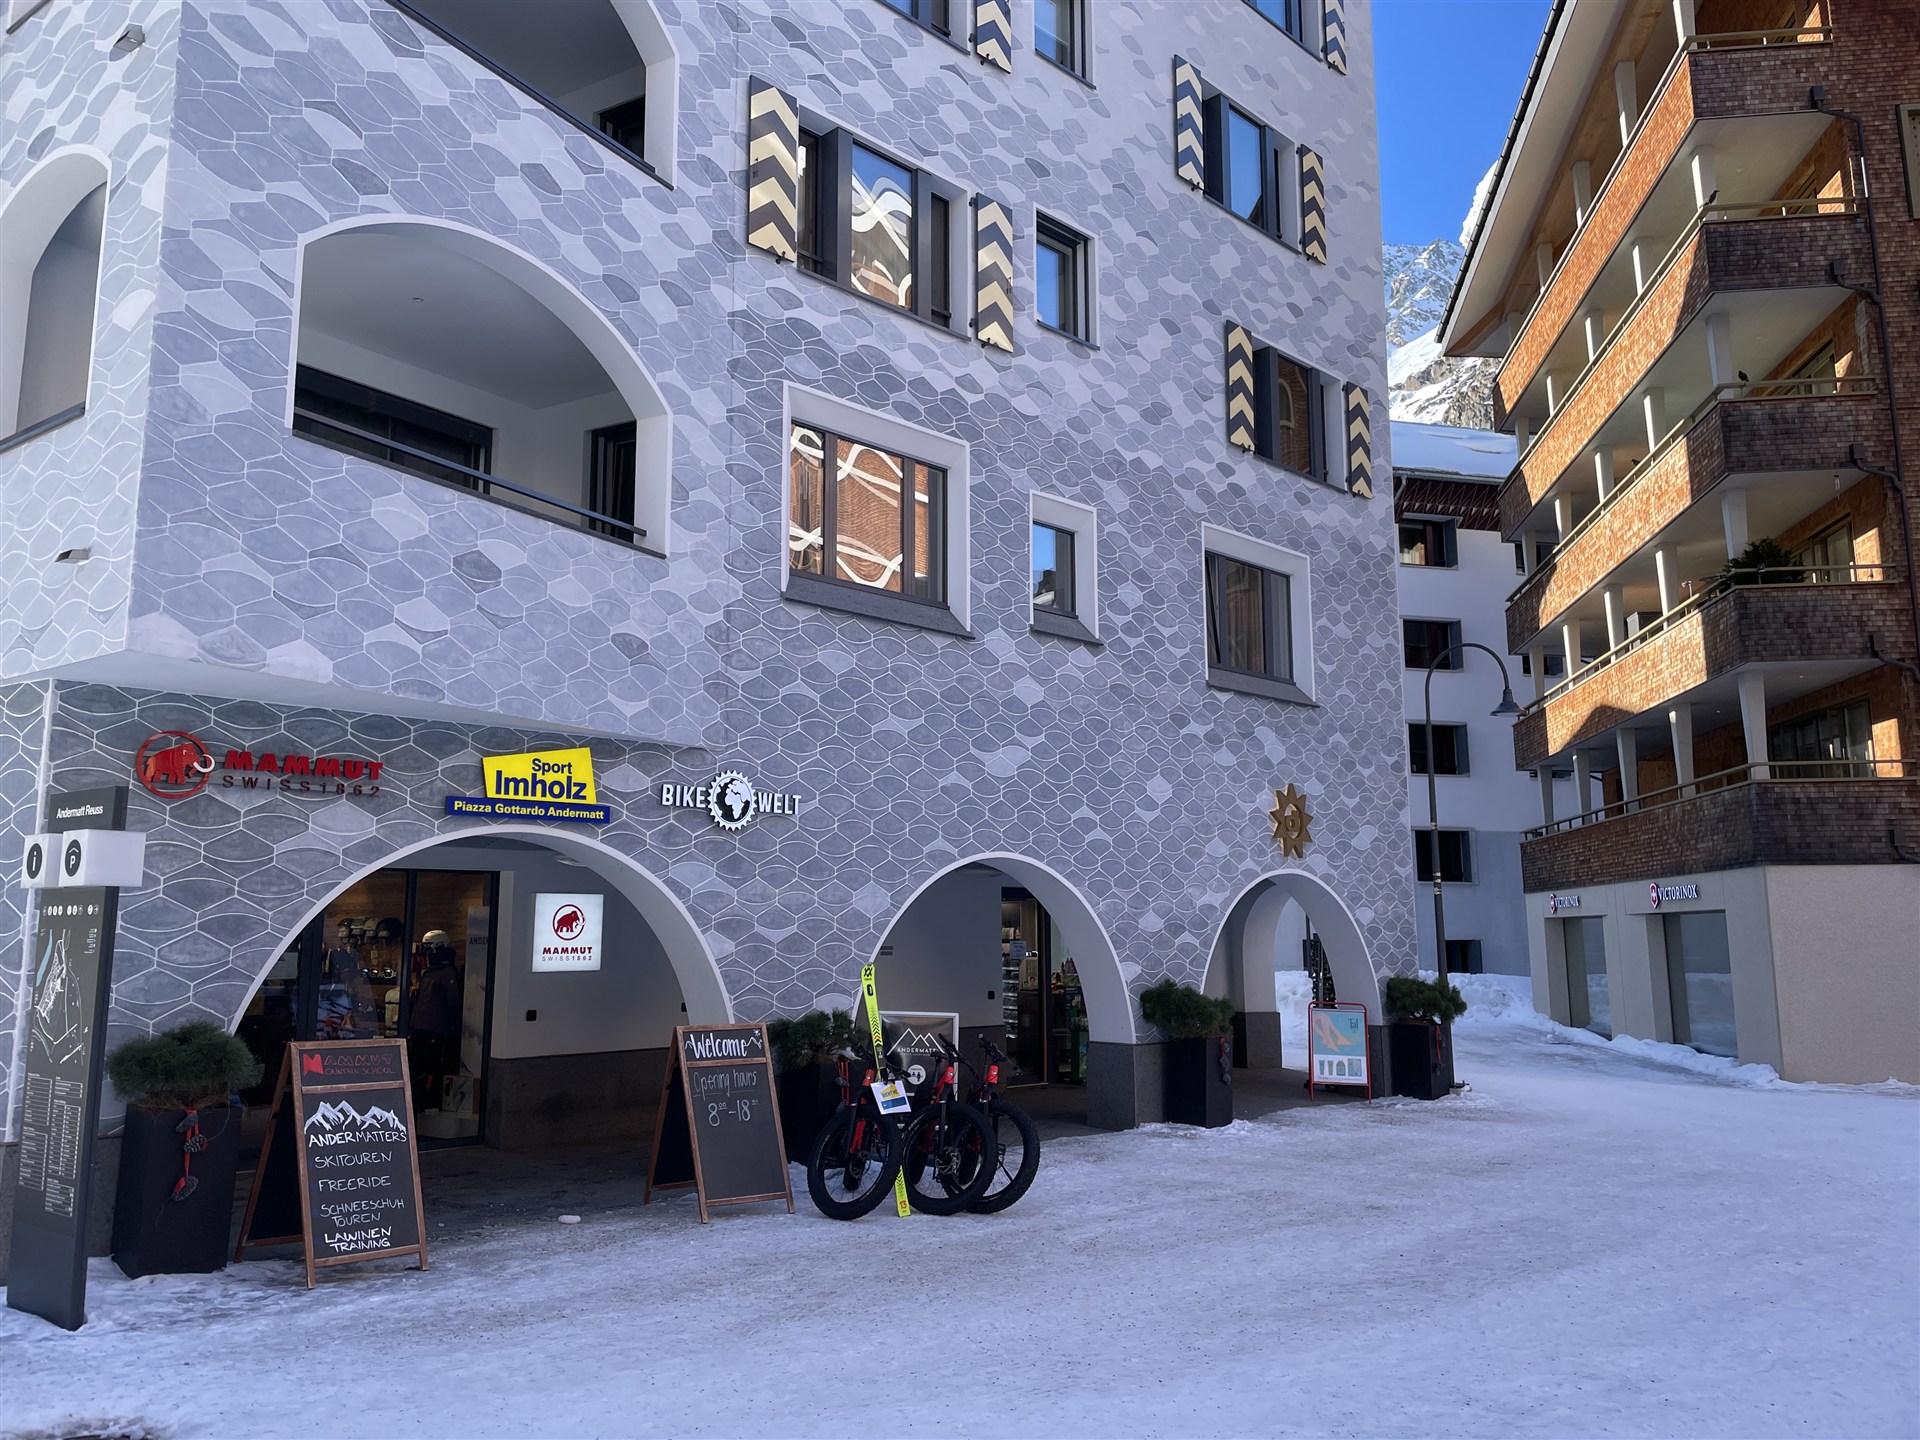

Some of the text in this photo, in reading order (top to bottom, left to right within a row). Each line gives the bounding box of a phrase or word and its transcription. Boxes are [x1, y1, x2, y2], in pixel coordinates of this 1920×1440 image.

[224, 750, 383, 781] MAMMUT
[532, 758, 573, 776] Sport
[495, 770, 587, 800] Imholz
[661, 783, 802, 815] BIKE WELT
[56, 804, 104, 819] Andermatt Reuss
[454, 800, 605, 820] Piazza Gottardo Andermatt
[1657, 884, 1698, 901] VICTORINOX
[542, 946, 593, 955] MAMMUT
[690, 1032, 748, 1059] Welcome
[693, 1068, 757, 1101] Opening hours
[314, 1151, 392, 1169] SKITOUREN
[318, 1175, 391, 1192] FREERIDE
[320, 1198, 405, 1217] SCHNEESCHUH
[331, 1212, 380, 1227] TOUREN
[324, 1226, 392, 1243] LAWINEN
[329, 1237, 391, 1252] TRAINING
